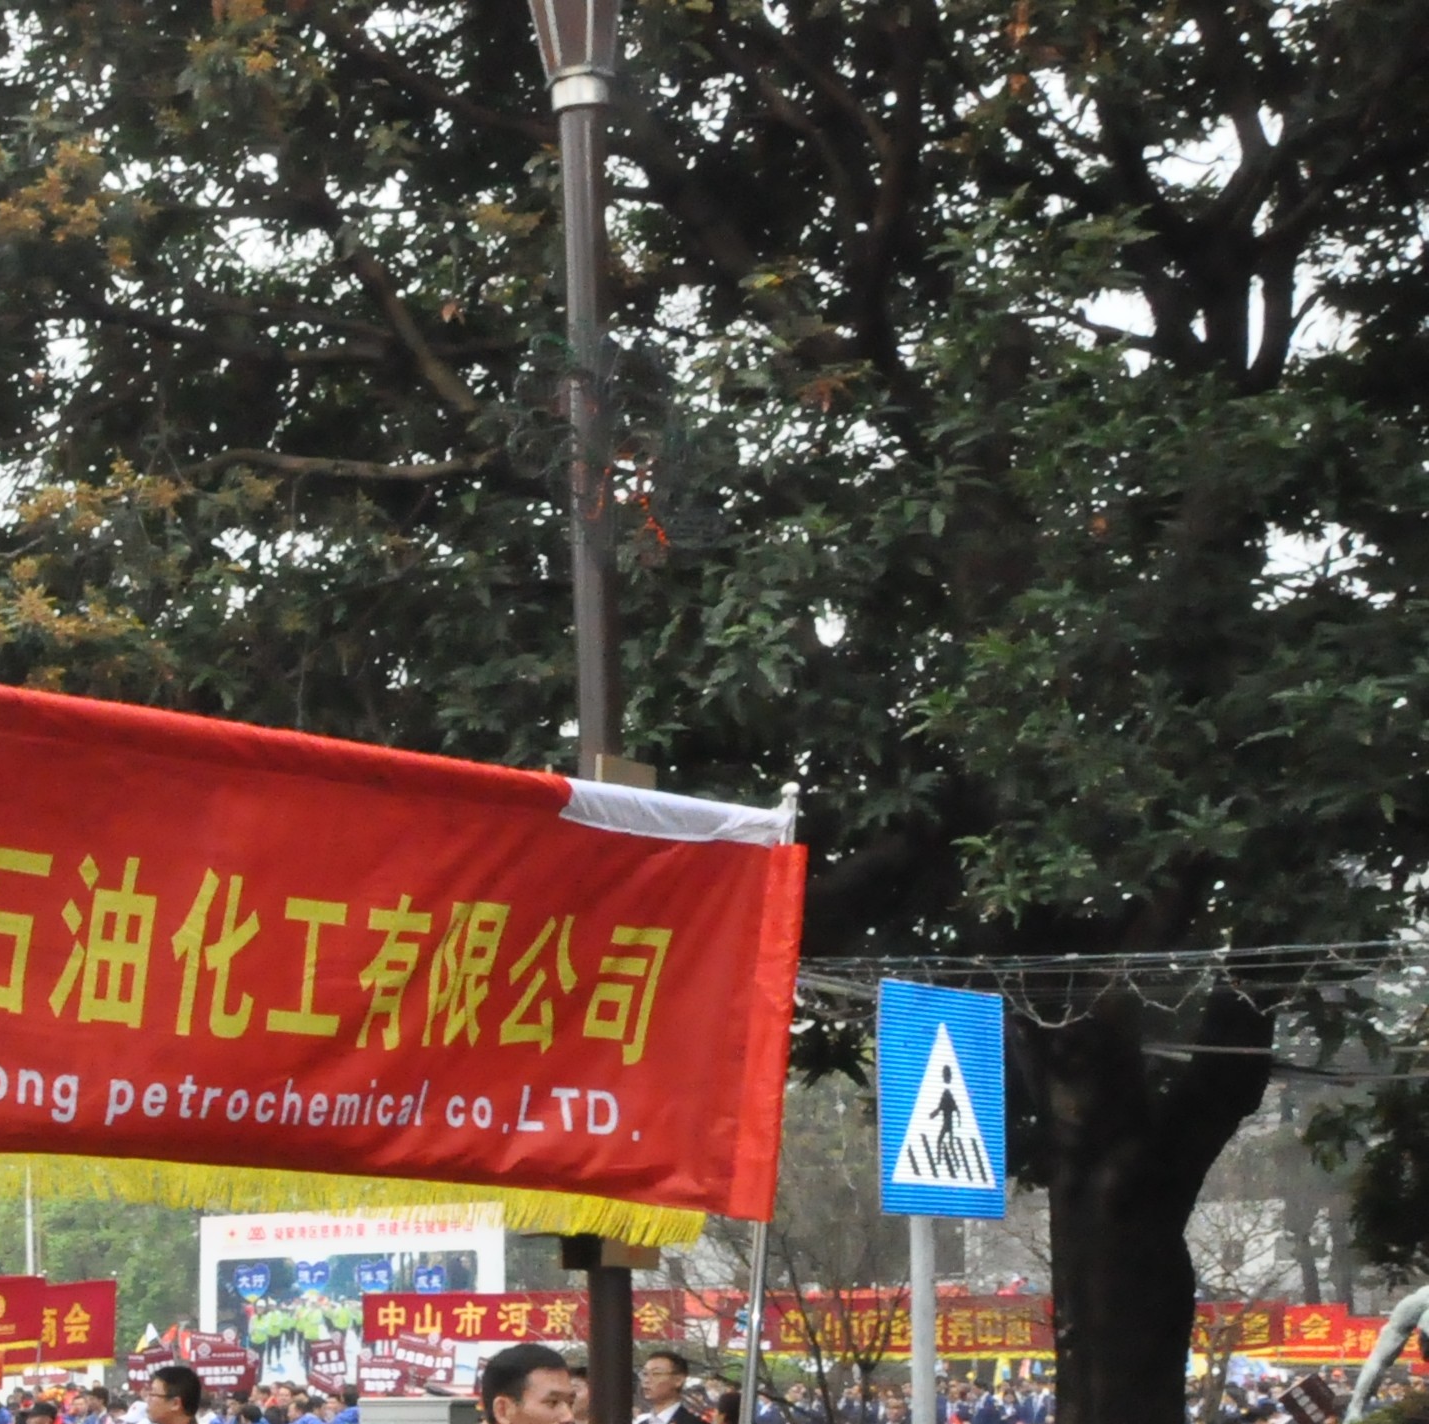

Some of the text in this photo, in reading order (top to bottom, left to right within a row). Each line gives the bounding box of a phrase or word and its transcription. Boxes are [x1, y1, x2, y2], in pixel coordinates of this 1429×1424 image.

[104, 1073, 426, 1127] petrochemical
[377, 1299, 672, 1337] 中山市河南会
